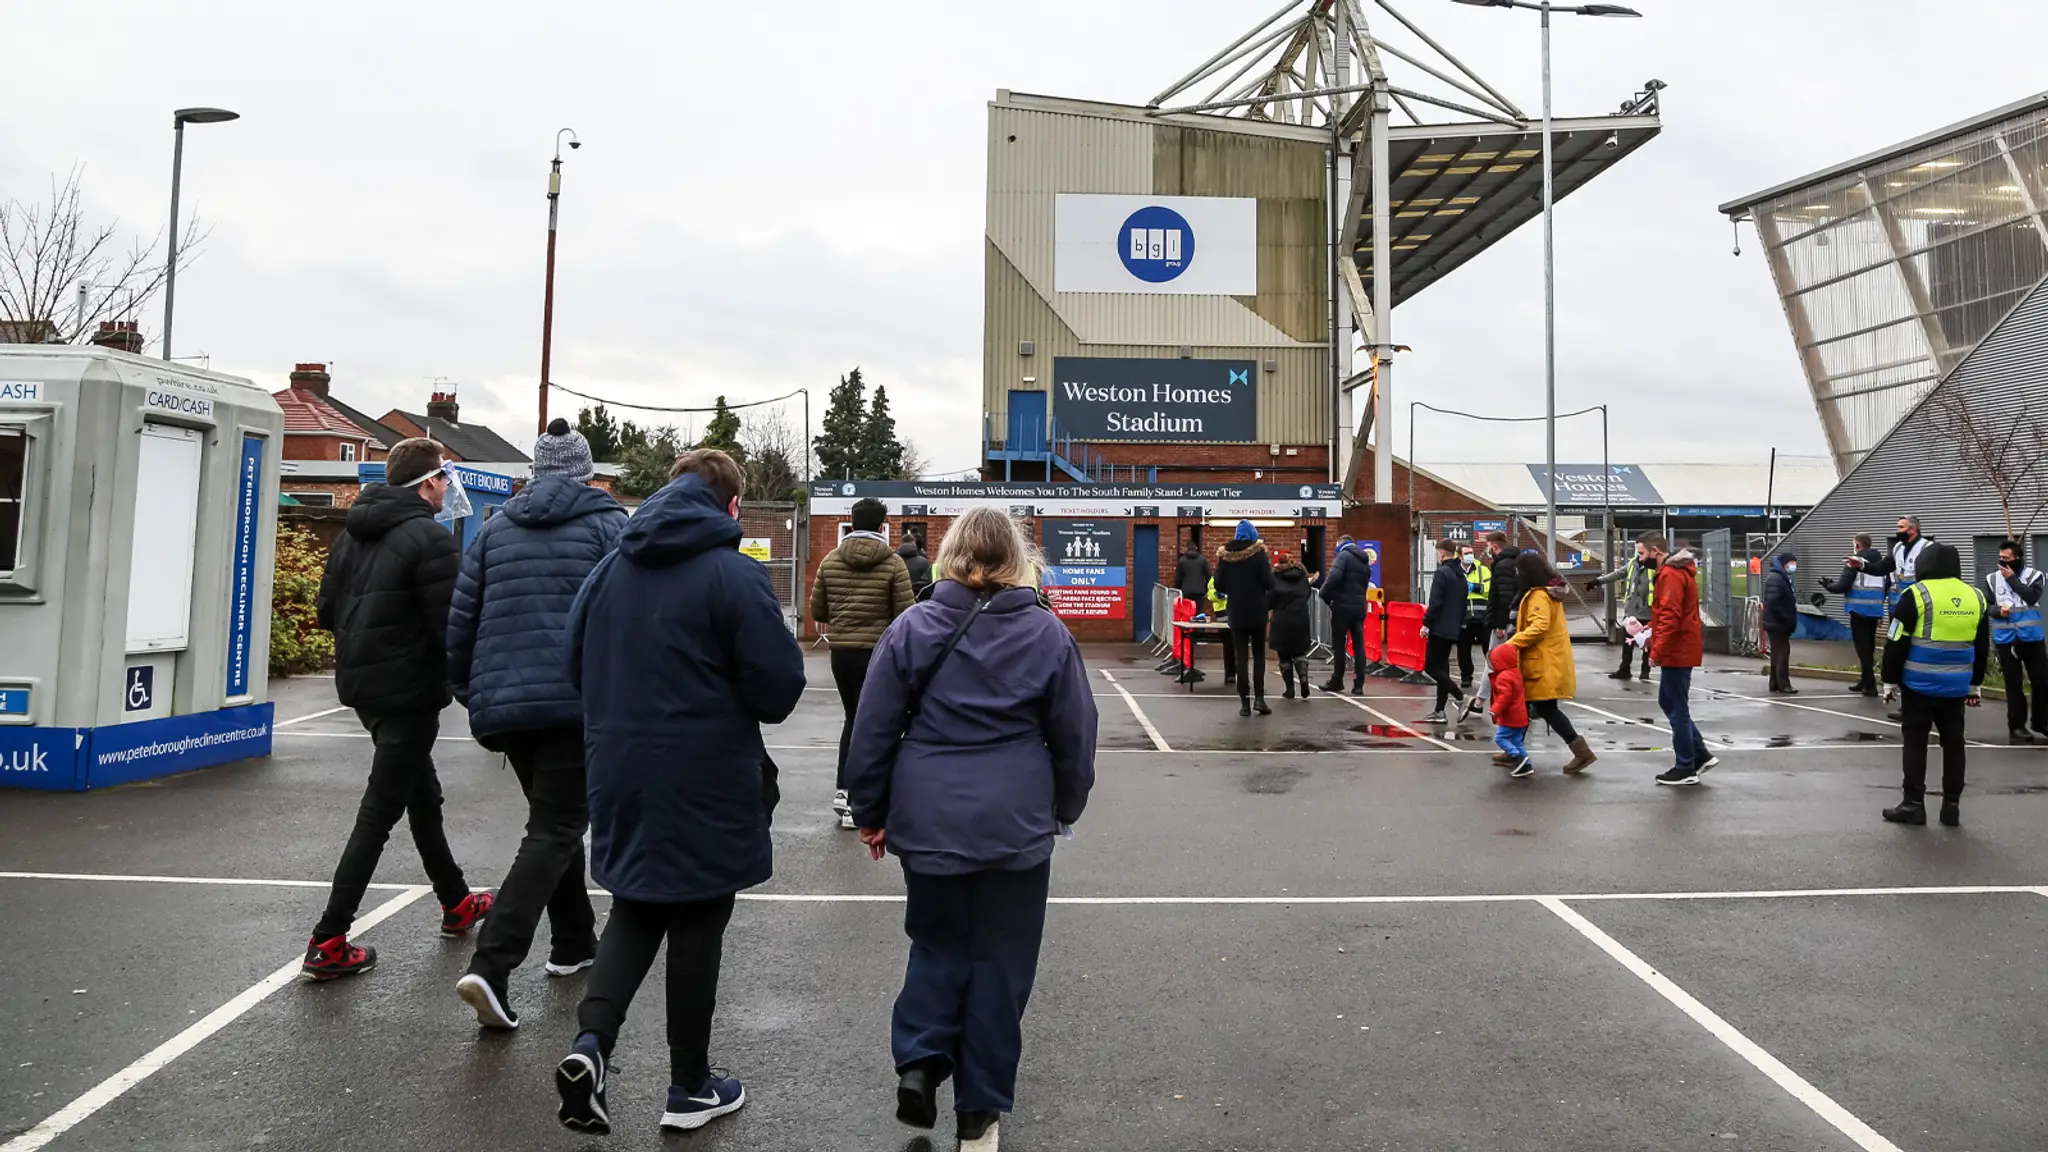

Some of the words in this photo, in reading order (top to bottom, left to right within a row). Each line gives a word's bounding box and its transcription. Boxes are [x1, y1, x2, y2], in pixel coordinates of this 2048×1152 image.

[1135, 238, 1175, 258] bgl
[0, 383, 36, 399] ASH
[1063, 382, 1146, 402] Weston
[1153, 383, 1232, 404] Homes
[148, 391, 210, 415] CARD/CASH
[1107, 412, 1203, 433] Stadium
[458, 470, 477, 486] CKET
[478, 474, 508, 491] ENQUIRIES
[914, 486, 949, 496] Weston
[951, 486, 986, 496] Homes
[987, 486, 1035, 496] Welcomes
[1036, 487, 1054, 496] You
[1056, 487, 1070, 496] To
[1071, 487, 1091, 496] The
[1092, 487, 1119, 497] South
[1122, 487, 1152, 499] Family
[1154, 487, 1183, 497] Stand
[1190, 487, 1219, 497] Lower
[1221, 487, 1242, 497] Tier
[241, 457, 254, 564] PETERBOROUGH
[1071, 577, 1096, 585] ONLY
[238, 567, 248, 631] RECLINER
[234, 634, 243, 687] CENTRE
[98, 722, 268, 765] www.peterboroughreclinercentre.co.uk
[0, 743, 48, 771] .uk
